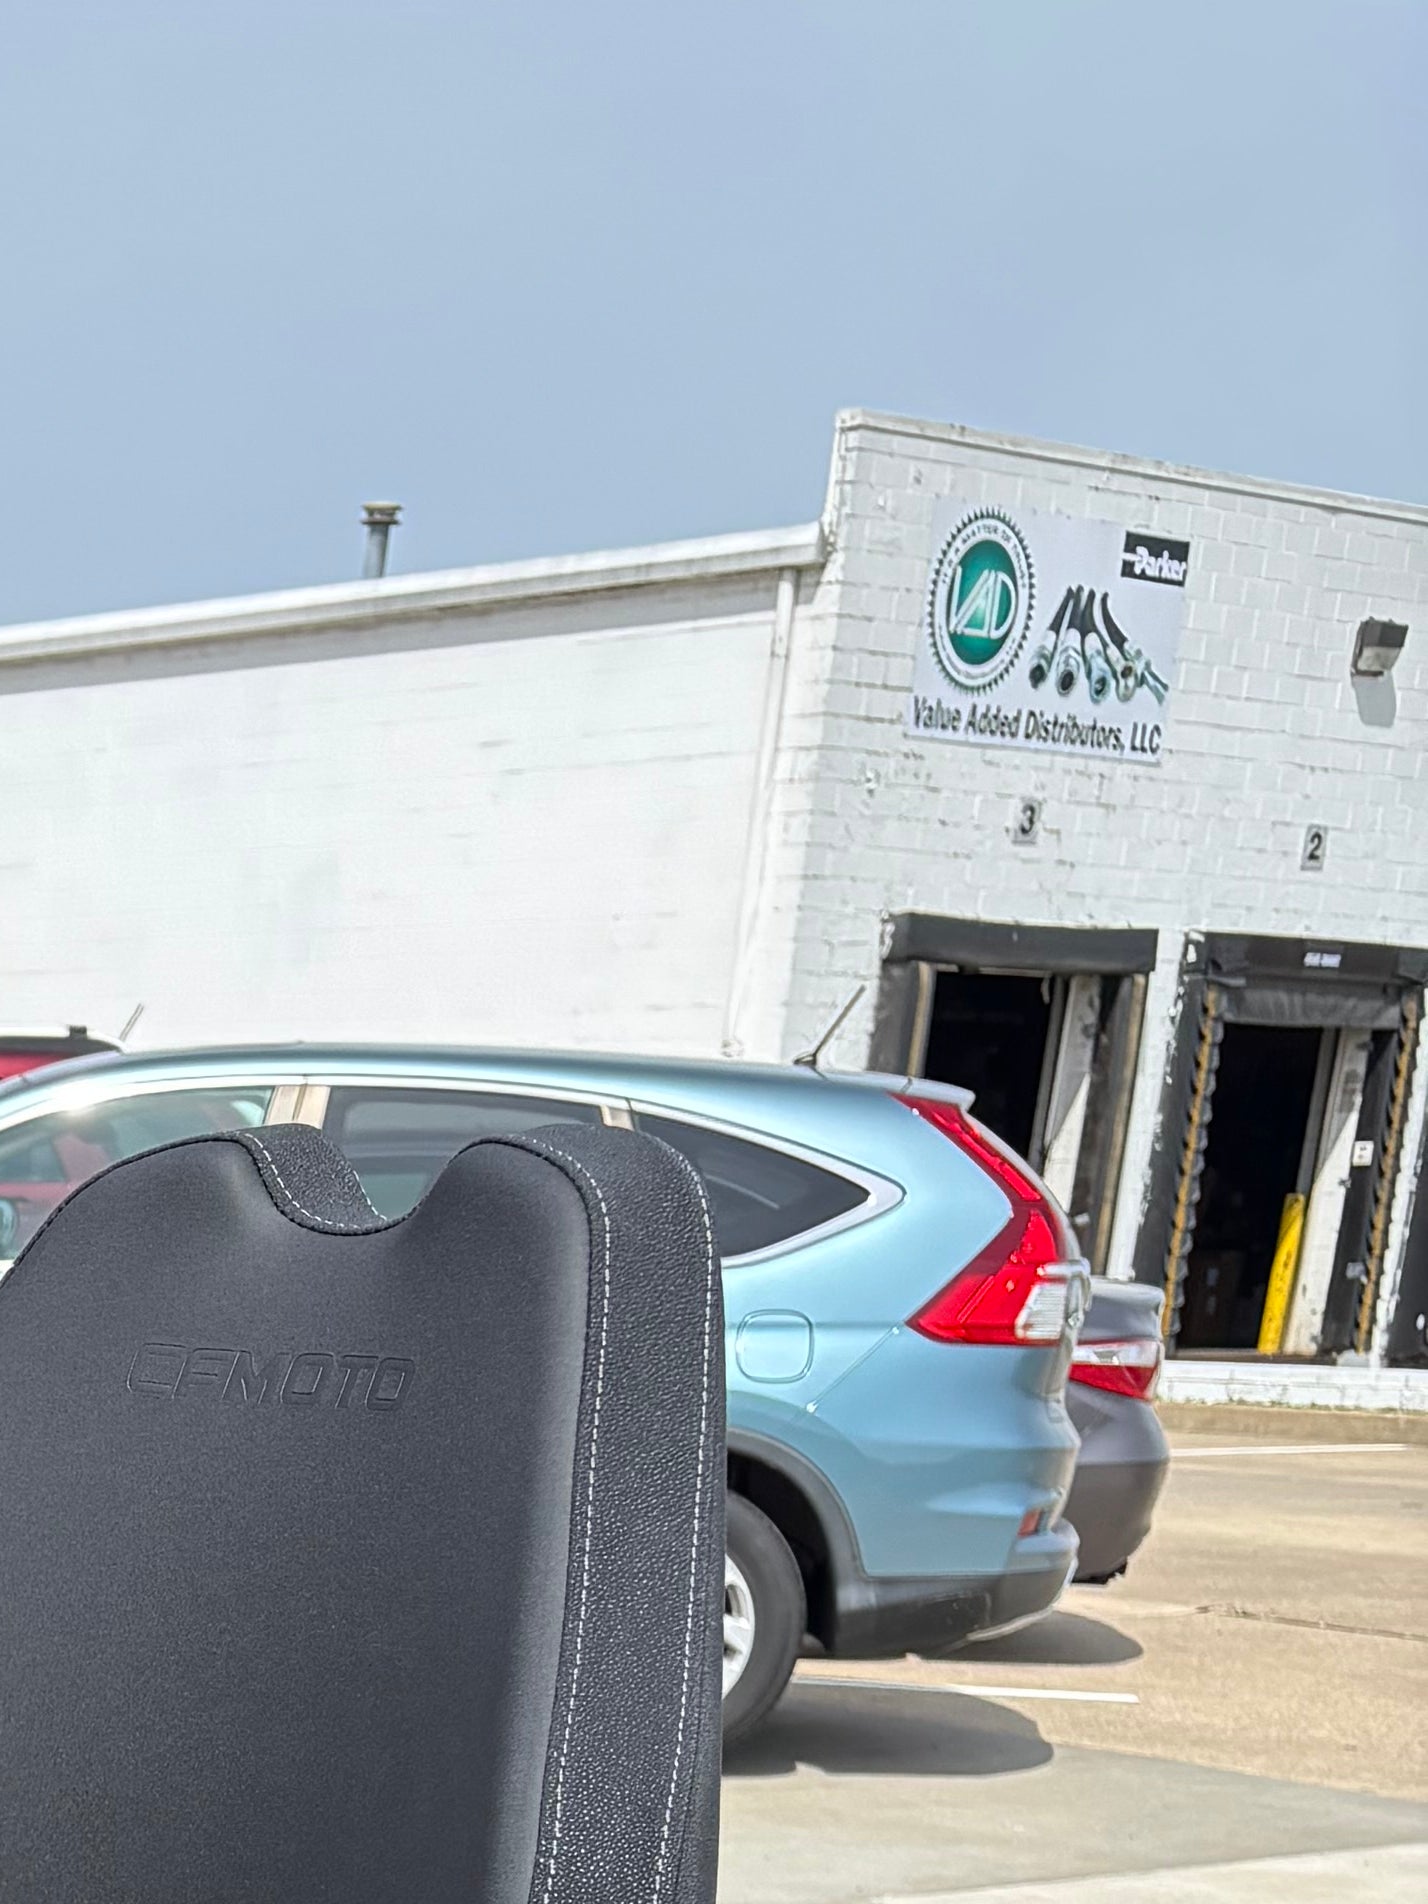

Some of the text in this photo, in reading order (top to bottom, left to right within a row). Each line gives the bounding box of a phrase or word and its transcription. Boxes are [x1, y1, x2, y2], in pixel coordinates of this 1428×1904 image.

[1134, 546, 1186, 581] Parker
[913, 696, 1162, 755] Value Added Distributors, LLC
[1020, 803, 1036, 834] 3
[1307, 831, 1323, 860] 2
[127, 1342, 414, 1410] CFMOTO
